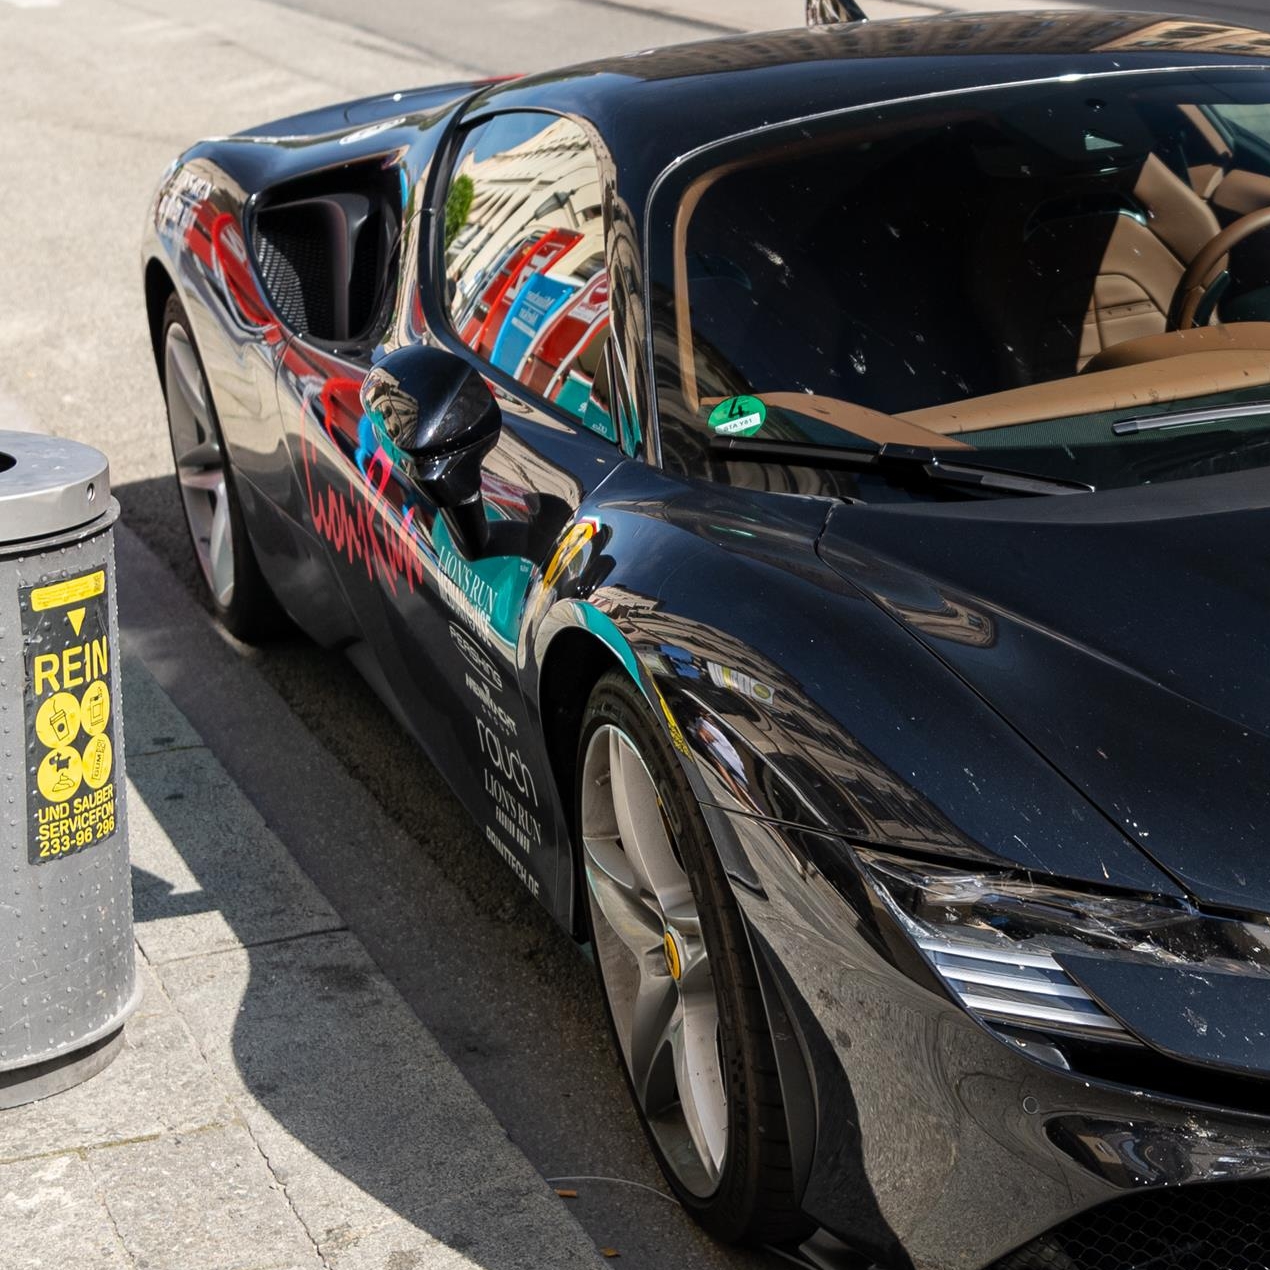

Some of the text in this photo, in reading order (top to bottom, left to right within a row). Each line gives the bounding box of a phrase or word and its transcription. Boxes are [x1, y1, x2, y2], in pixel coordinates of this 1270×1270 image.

[727, 398, 749, 419] 4
[438, 545, 473, 594] LION'S
[469, 574, 498, 615] RUN
[34, 634, 108, 696] REIN
[38, 783, 114, 823] UND SAUBER
[38, 799, 115, 841] SERVICEFON
[484, 768, 517, 819] LION'S
[518, 802, 541, 845] RUN
[39, 815, 115, 857] 233-96 296
